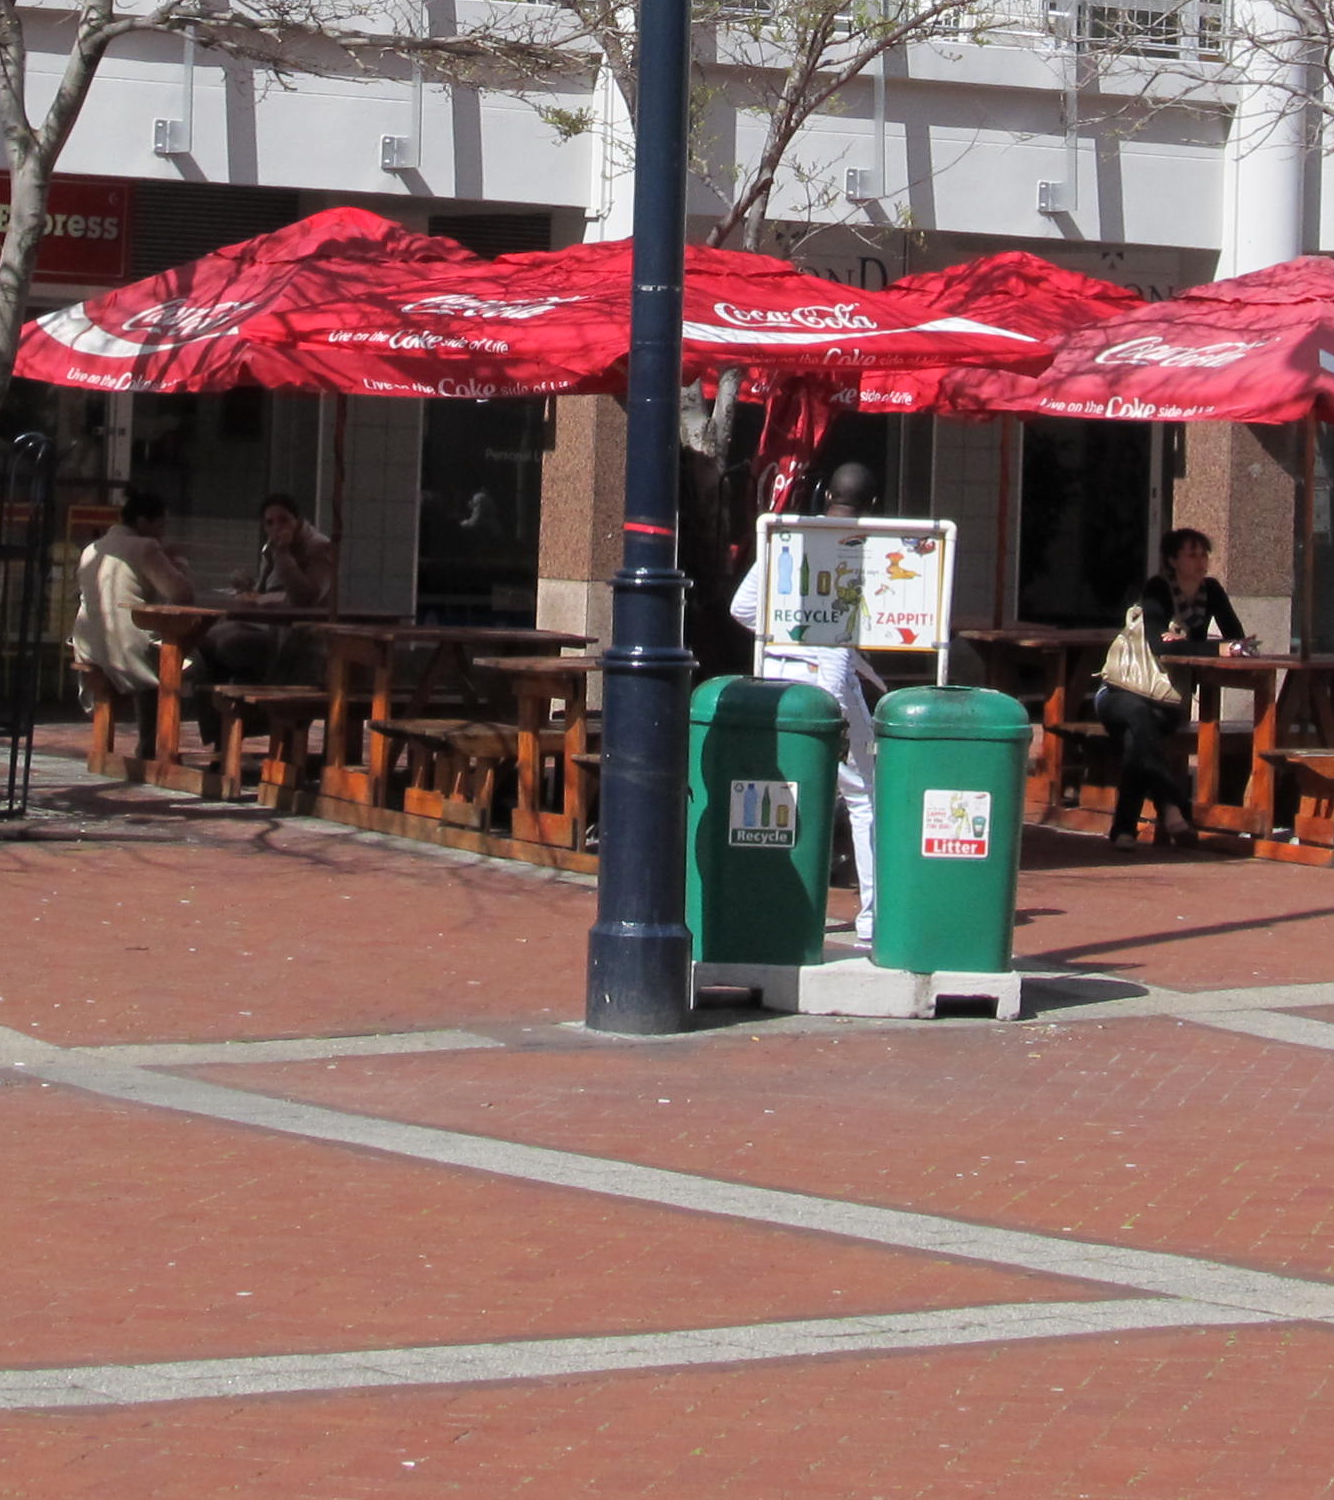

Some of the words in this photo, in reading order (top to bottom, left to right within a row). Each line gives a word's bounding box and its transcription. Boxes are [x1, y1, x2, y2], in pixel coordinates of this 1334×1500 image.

[713, 302, 878, 329] Coca-Cola
[328, 330, 353, 343] Live
[353, 332, 371, 342] on
[369, 331, 390, 343] the
[388, 329, 443, 350] Coke
[1094, 336, 1267, 368] Coca-Cola
[66, 367, 88, 381] Live
[362, 378, 393, 391] Live
[438, 377, 496, 398] Coke
[859, 389, 881, 403] side
[1066, 400, 1083, 413] on
[1084, 400, 1104, 415] the
[1104, 396, 1157, 419] Coke
[1157, 404, 1183, 418] side
[876, 612, 934, 626] ZAPPIT!
[736, 829, 788, 844] Recycle
[932, 839, 979, 854] Litter
